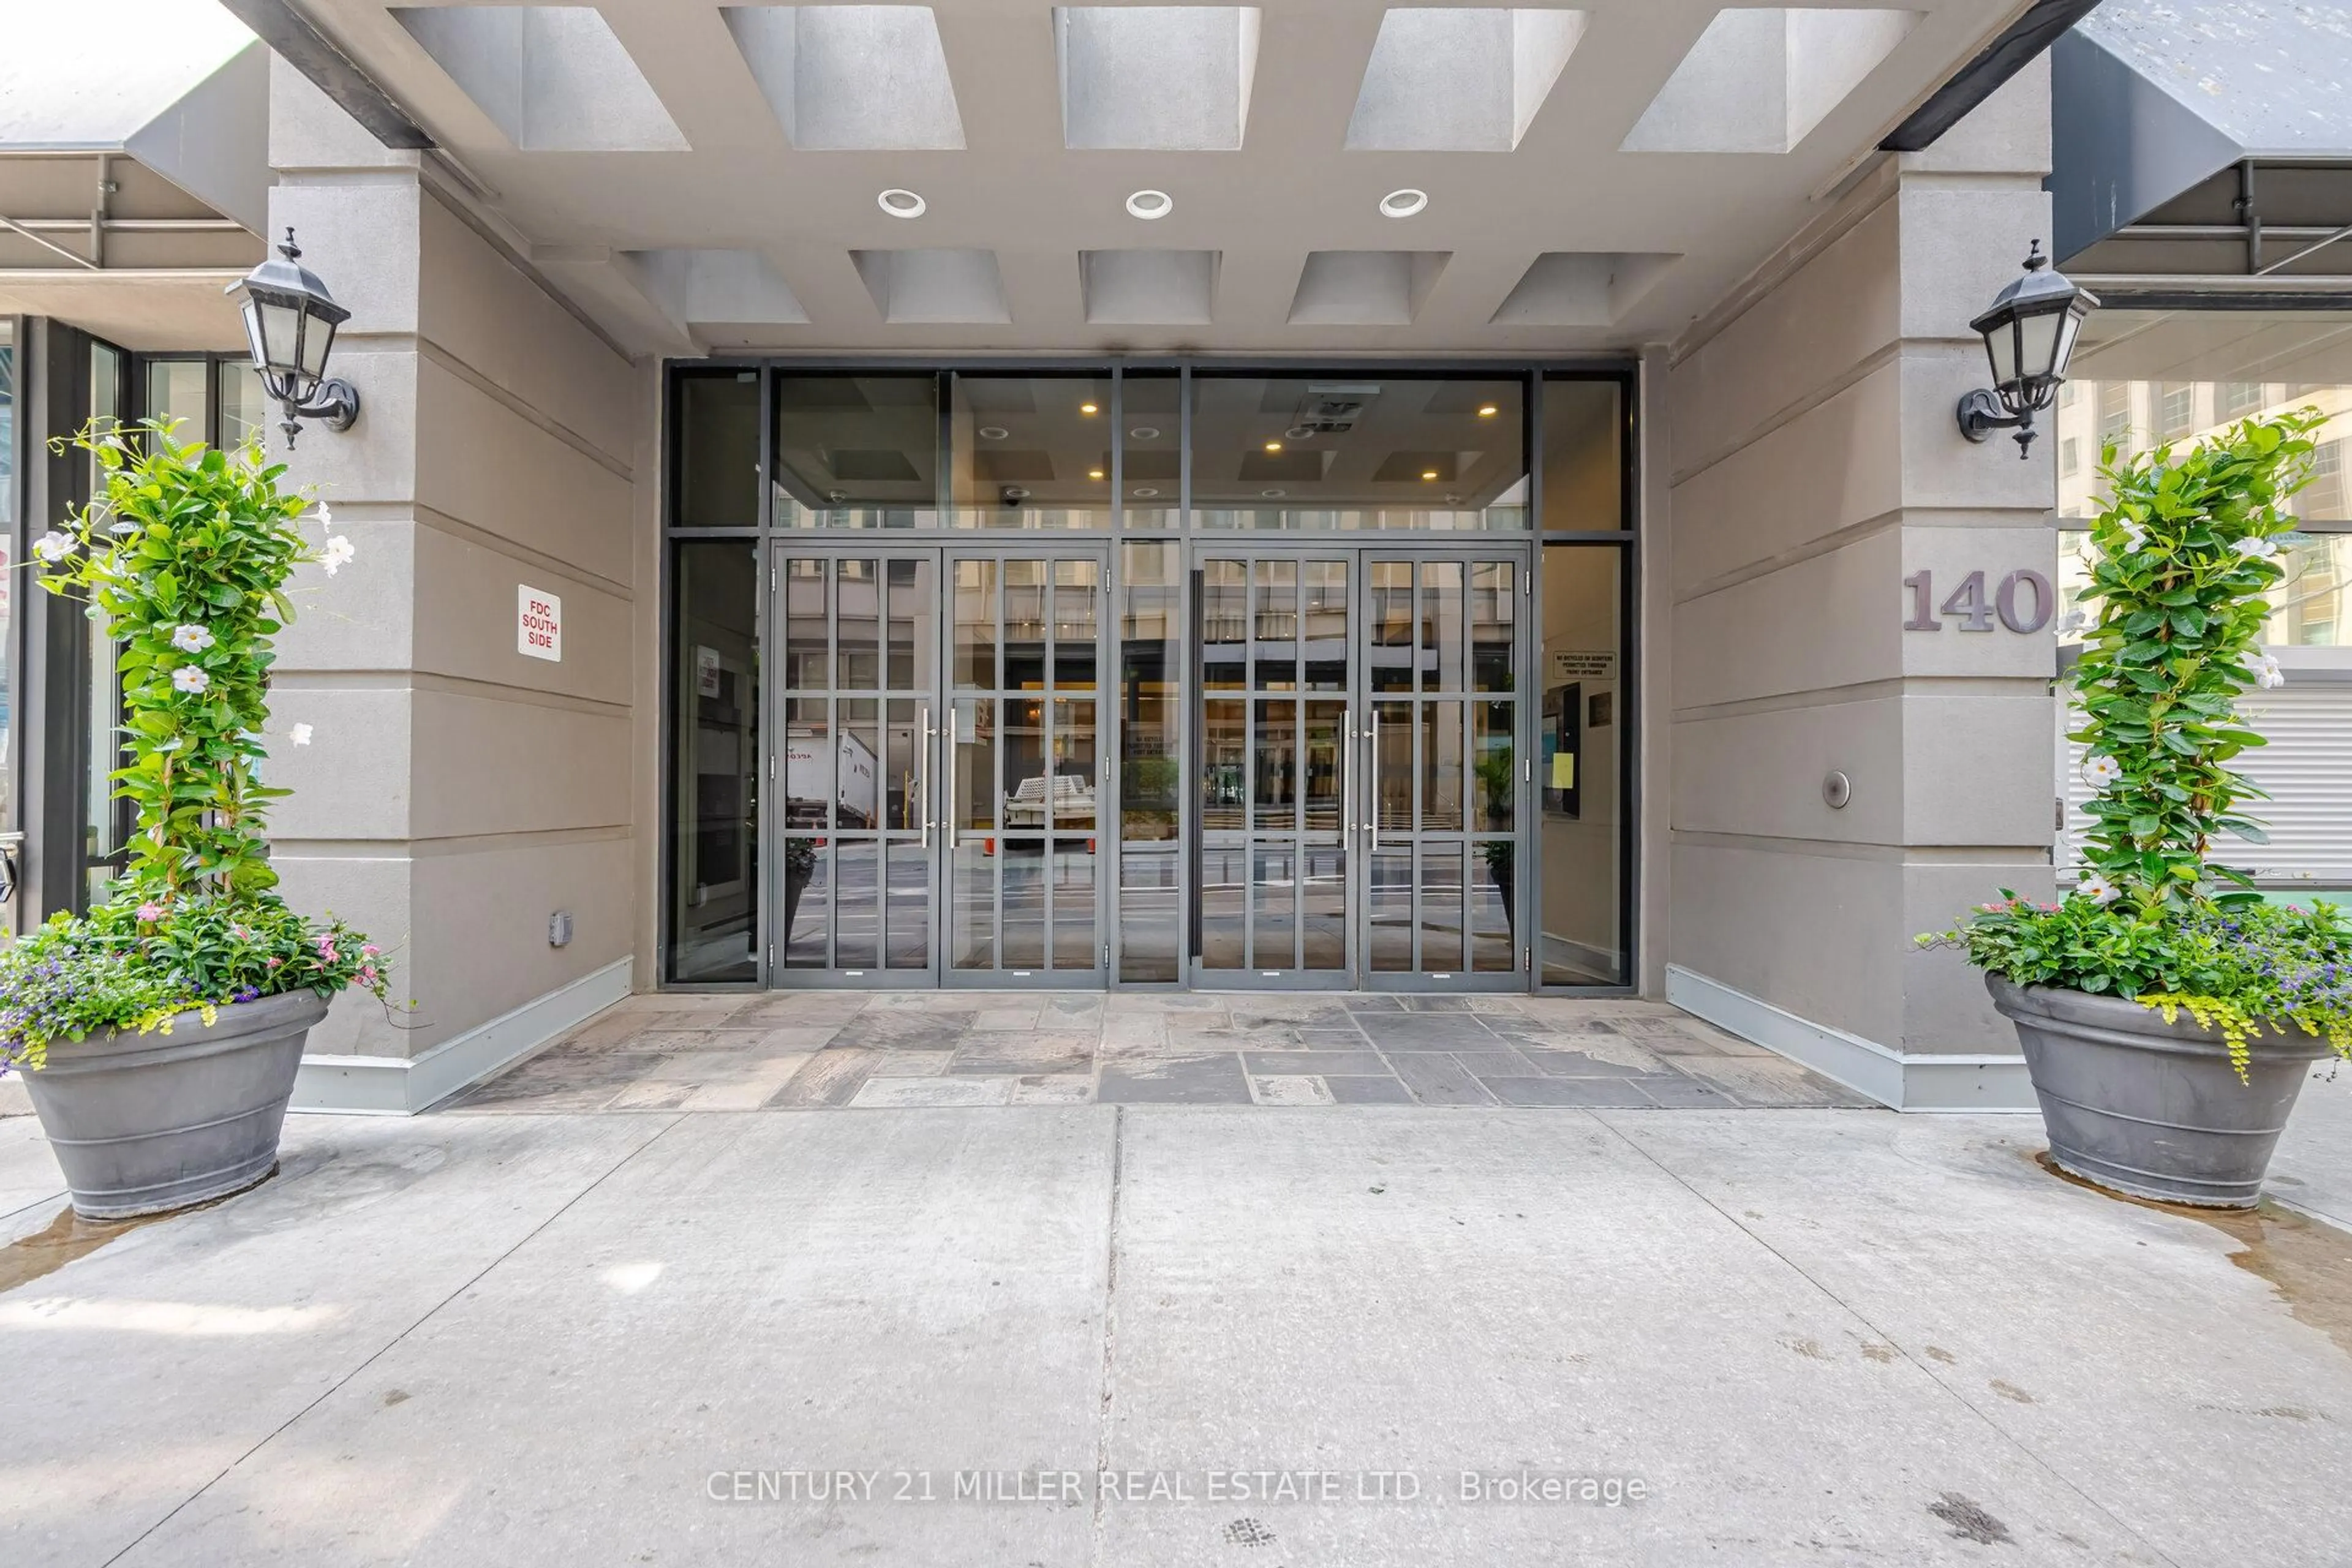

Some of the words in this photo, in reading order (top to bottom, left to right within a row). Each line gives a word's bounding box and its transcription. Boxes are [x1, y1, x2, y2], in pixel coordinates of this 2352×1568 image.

[530, 600, 551, 617] FDC
[1904, 569, 2053, 633] 140
[522, 614, 557, 634] SOUTH
[529, 632, 552, 648] SIDE
